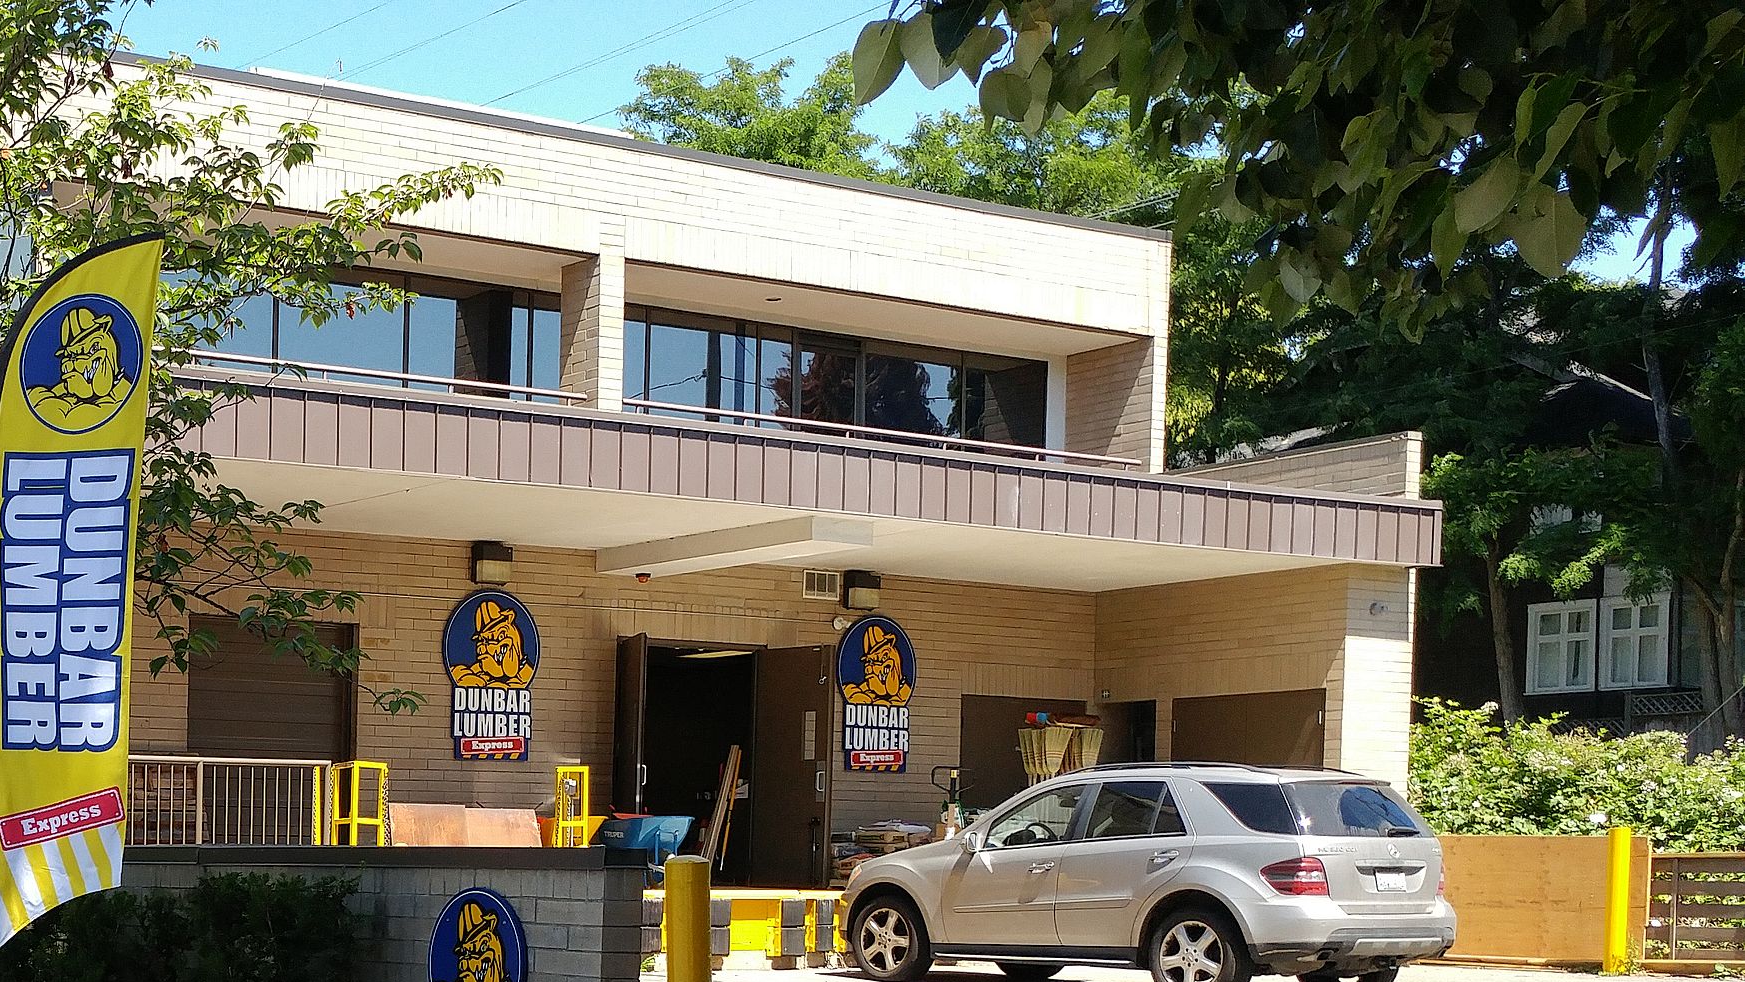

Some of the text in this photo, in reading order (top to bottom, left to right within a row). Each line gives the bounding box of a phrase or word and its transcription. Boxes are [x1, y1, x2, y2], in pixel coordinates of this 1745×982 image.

[3, 457, 68, 746] LUMBER
[59, 454, 130, 748] DUNBAR
[454, 687, 531, 713] DUNBAR
[453, 712, 532, 739] LUMBER
[845, 704, 909, 729] DUNBAR
[471, 740, 514, 752] Express
[844, 727, 909, 752] LUMBER
[20, 803, 102, 837] Express
